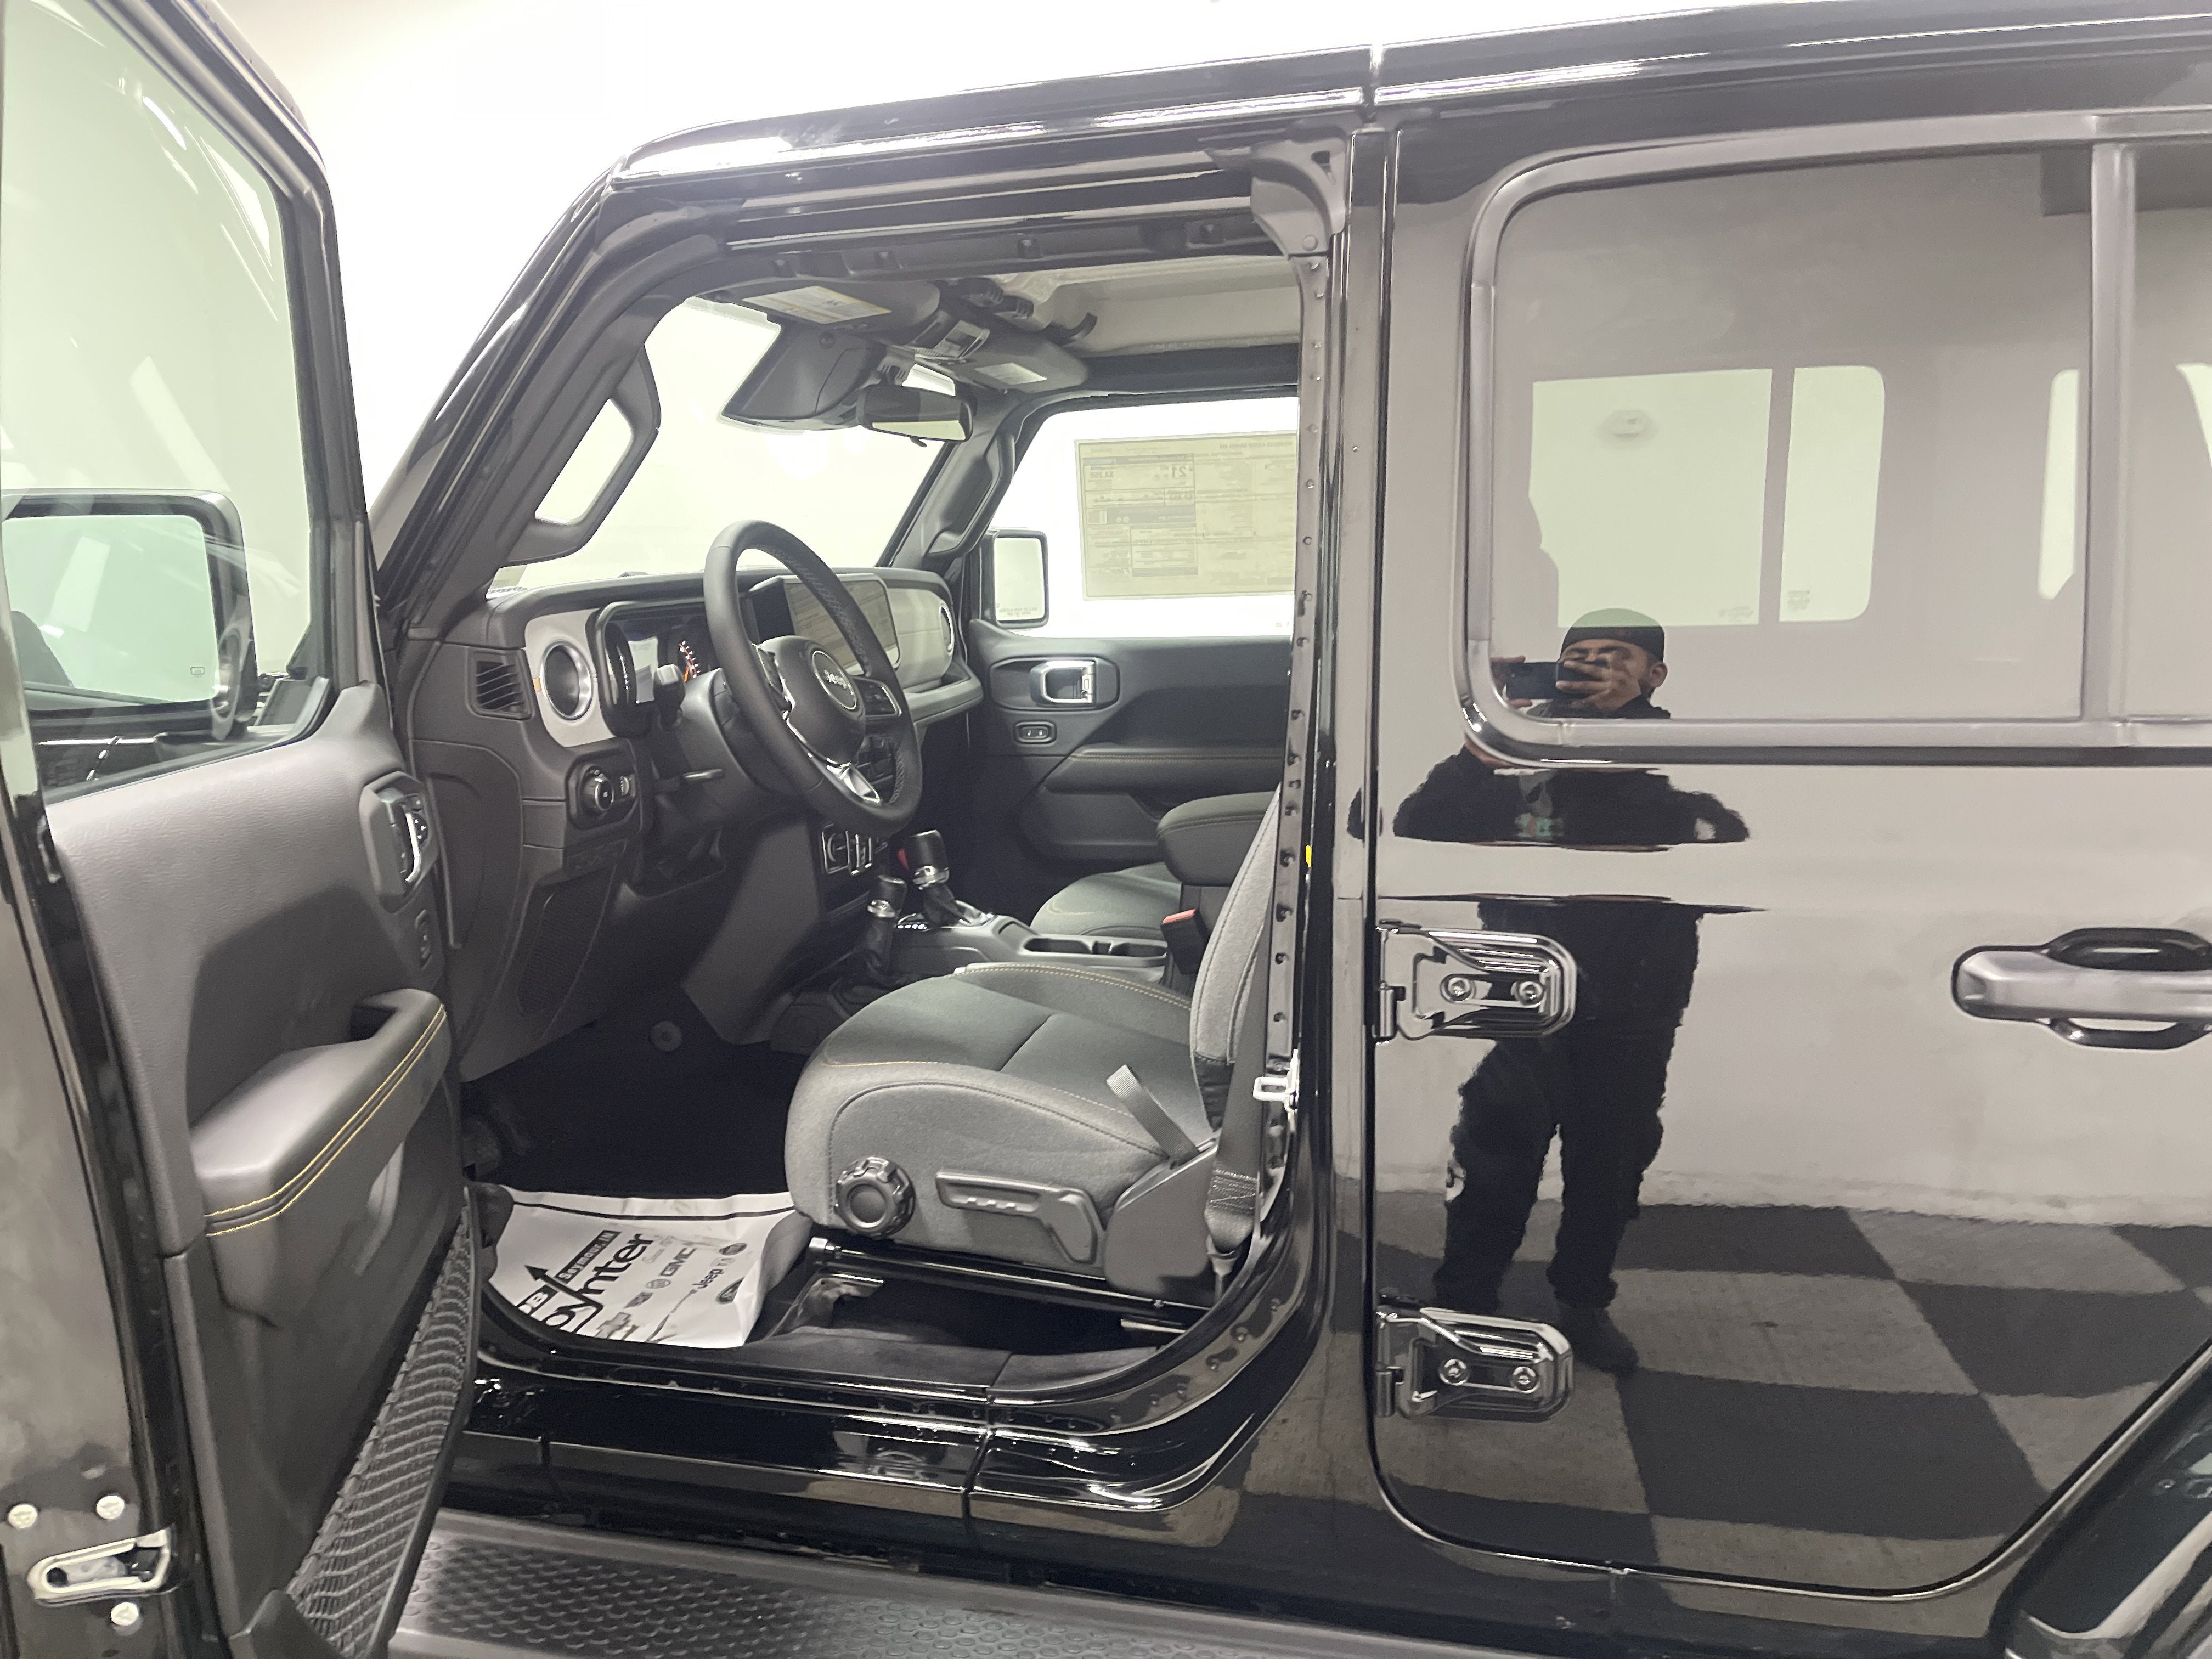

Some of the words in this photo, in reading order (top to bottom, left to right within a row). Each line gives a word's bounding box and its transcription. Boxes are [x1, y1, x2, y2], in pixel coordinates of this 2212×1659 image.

[659, 1247, 698, 1277] GMC
[541, 1233, 654, 1330] oynter
[692, 1268, 725, 1289] Jeep
[517, 1291, 549, 1314] OB
